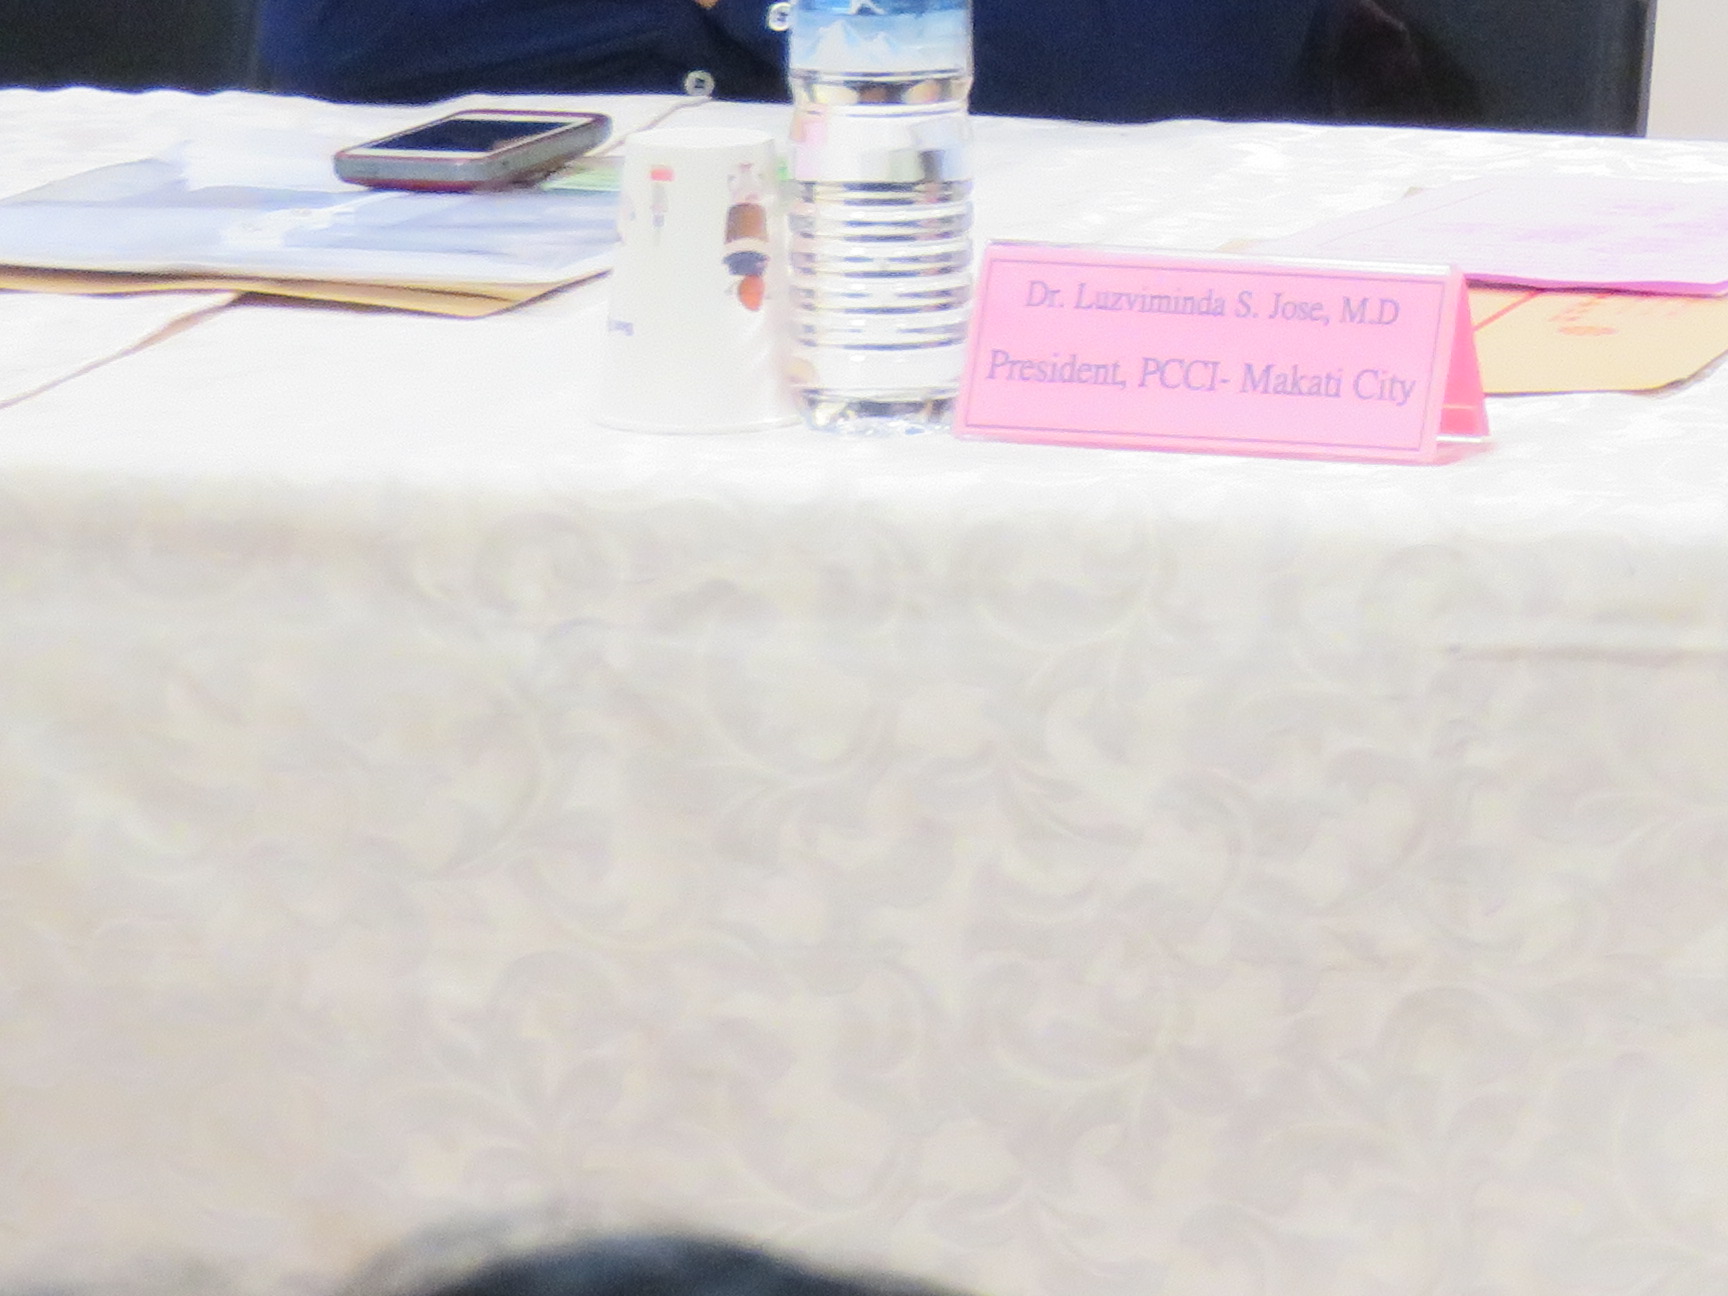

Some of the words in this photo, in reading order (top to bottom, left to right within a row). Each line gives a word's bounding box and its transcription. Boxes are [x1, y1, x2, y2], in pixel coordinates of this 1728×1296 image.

[1024, 279, 1065, 309] Dr.
[1074, 281, 1226, 317] Luzviminda
[1235, 289, 1259, 319] S.
[1267, 292, 1331, 326] Jose,
[1339, 295, 1401, 326] M.D
[985, 348, 1127, 389] President,
[1138, 356, 1230, 392] PCCI-
[1240, 362, 1343, 398] Makati
[1352, 368, 1418, 407] City
